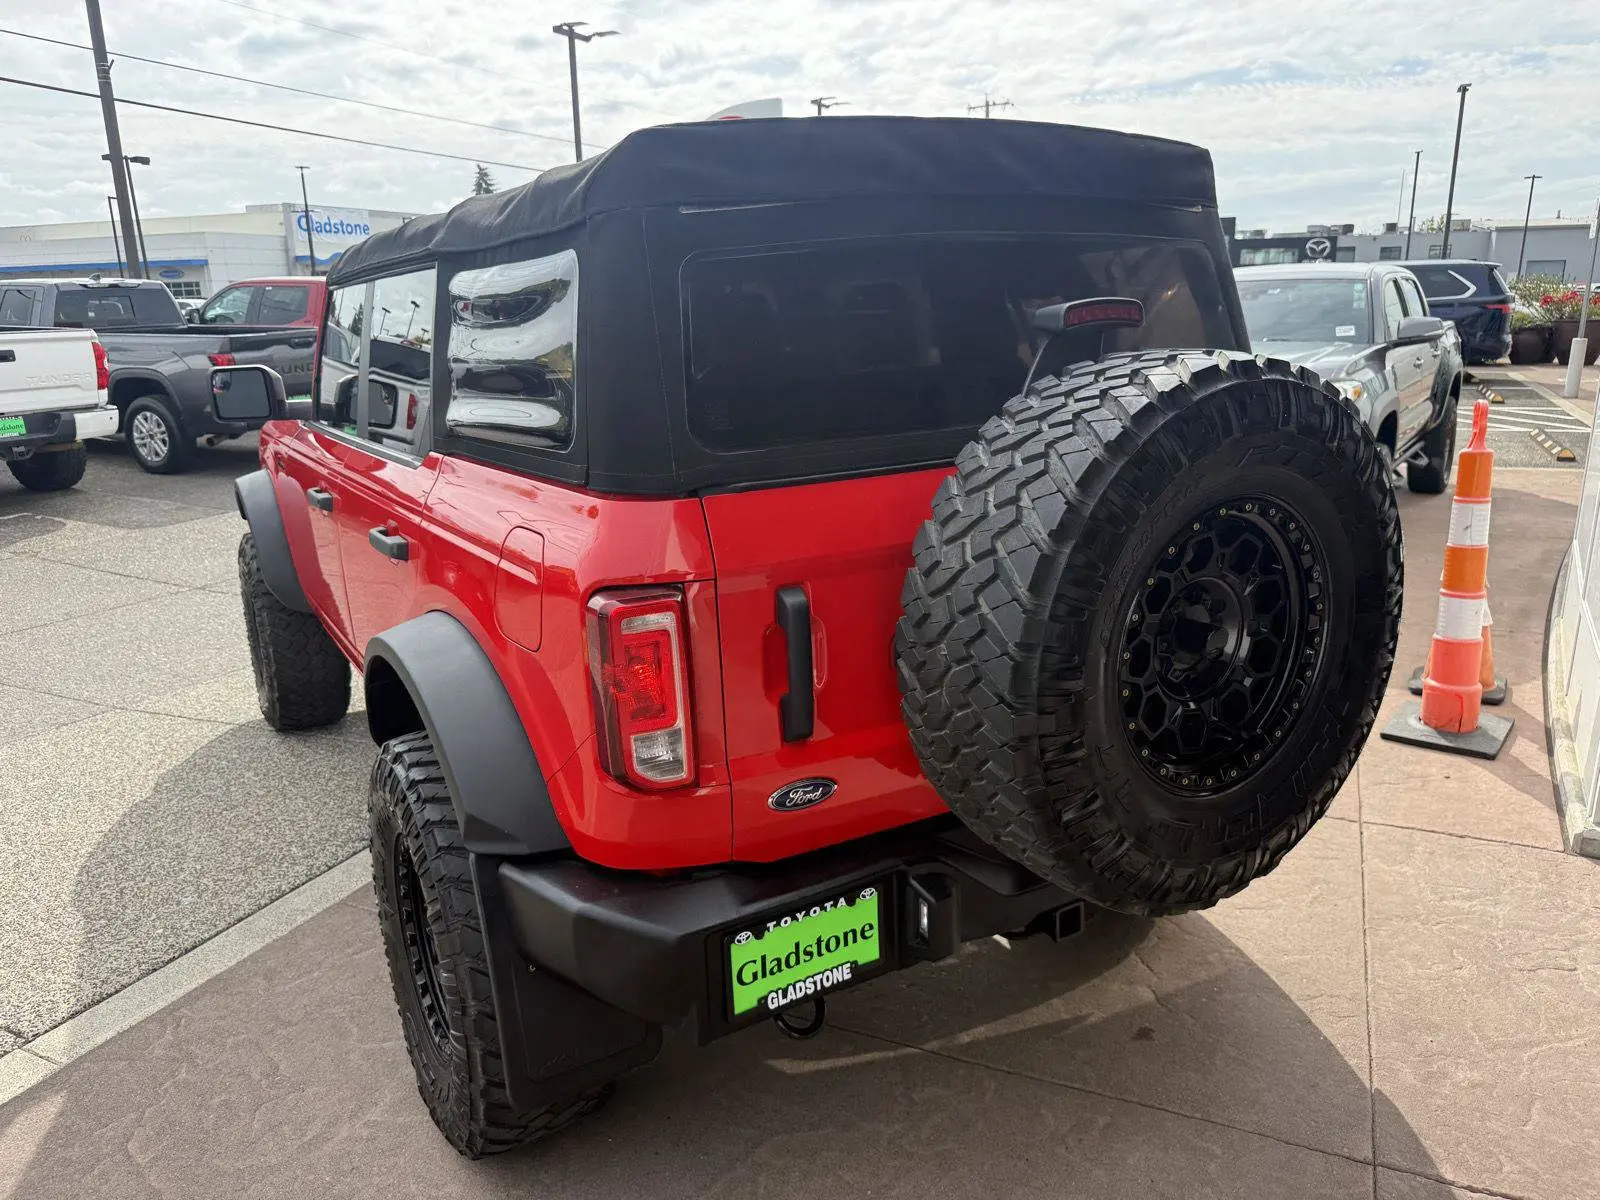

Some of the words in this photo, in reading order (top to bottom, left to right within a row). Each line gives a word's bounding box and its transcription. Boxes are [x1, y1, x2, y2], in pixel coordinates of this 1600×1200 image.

[297, 212, 370, 236] Gladstone
[785, 785, 824, 807] Ford
[766, 897, 848, 933] TOYOTA
[736, 922, 875, 987] Gladstone
[767, 962, 853, 1010] GLADSTONE
